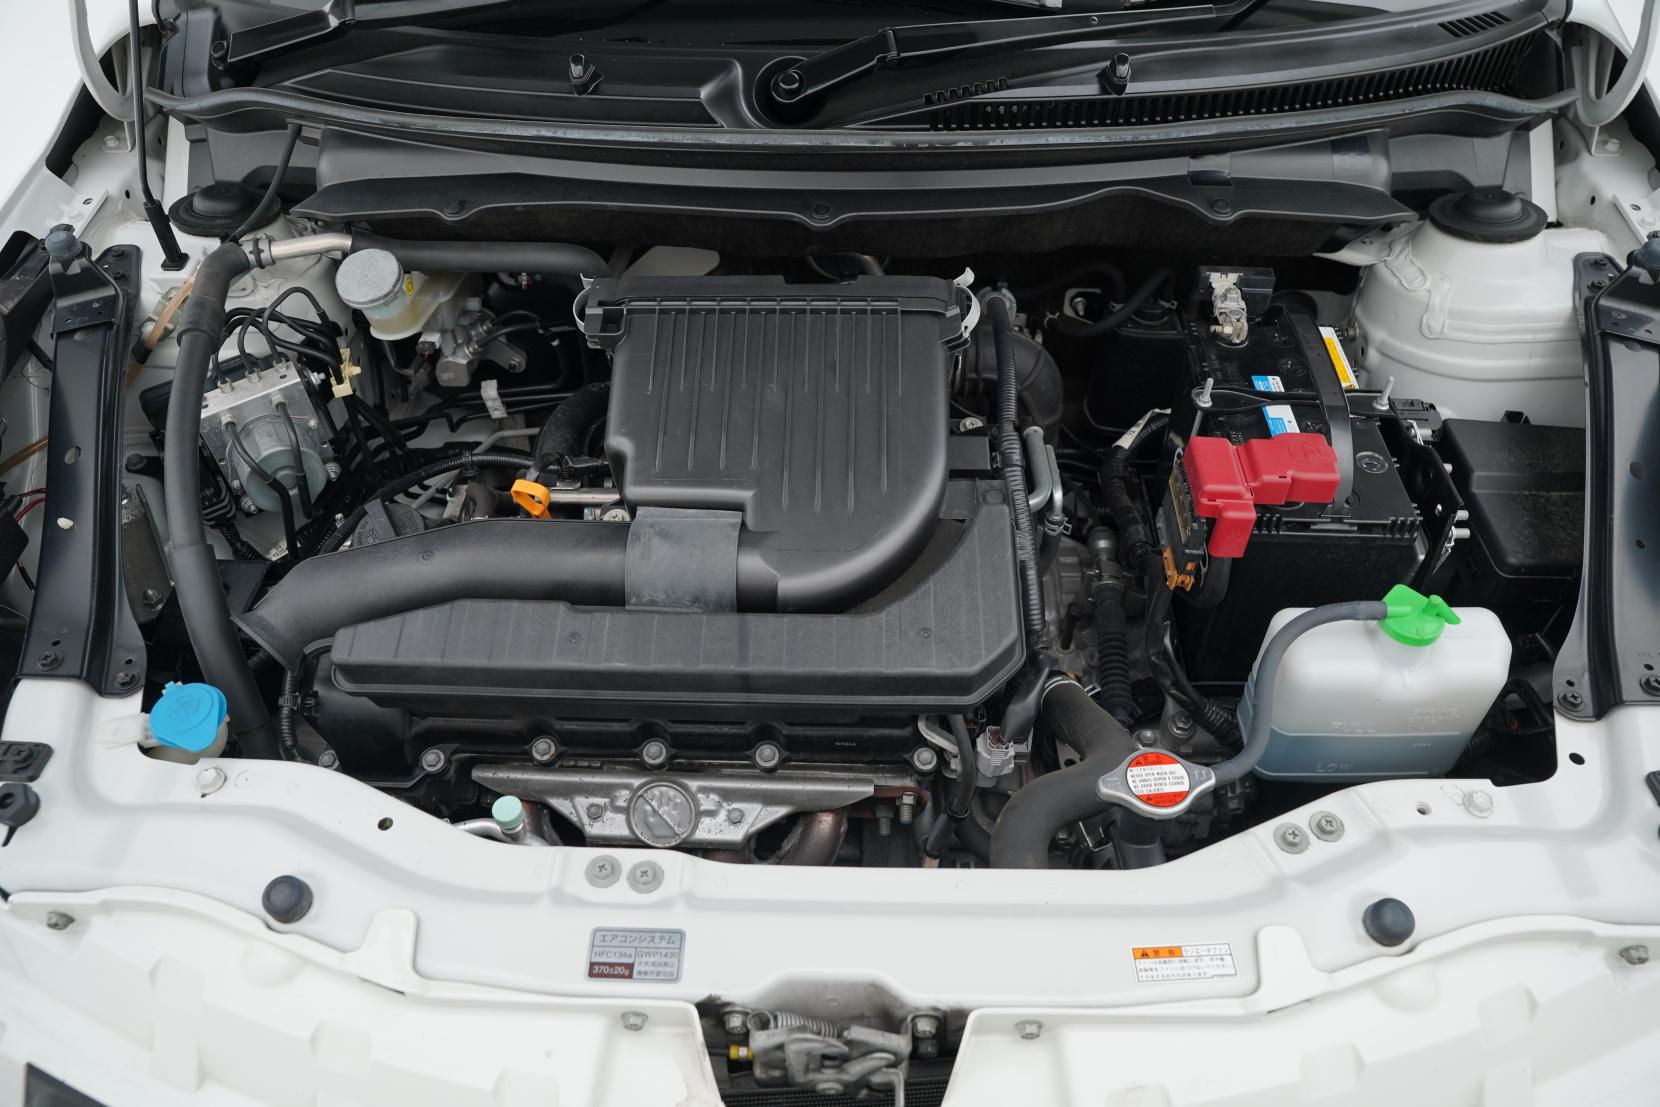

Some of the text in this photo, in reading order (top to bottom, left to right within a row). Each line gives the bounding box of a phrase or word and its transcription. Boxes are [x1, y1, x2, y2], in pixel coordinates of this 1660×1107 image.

[599, 933, 675, 945] エアコンシステム
[593, 950, 632, 959] HFC134a
[637, 950, 678, 960] GWP1430
[592, 964, 630, 976] 370±20g
